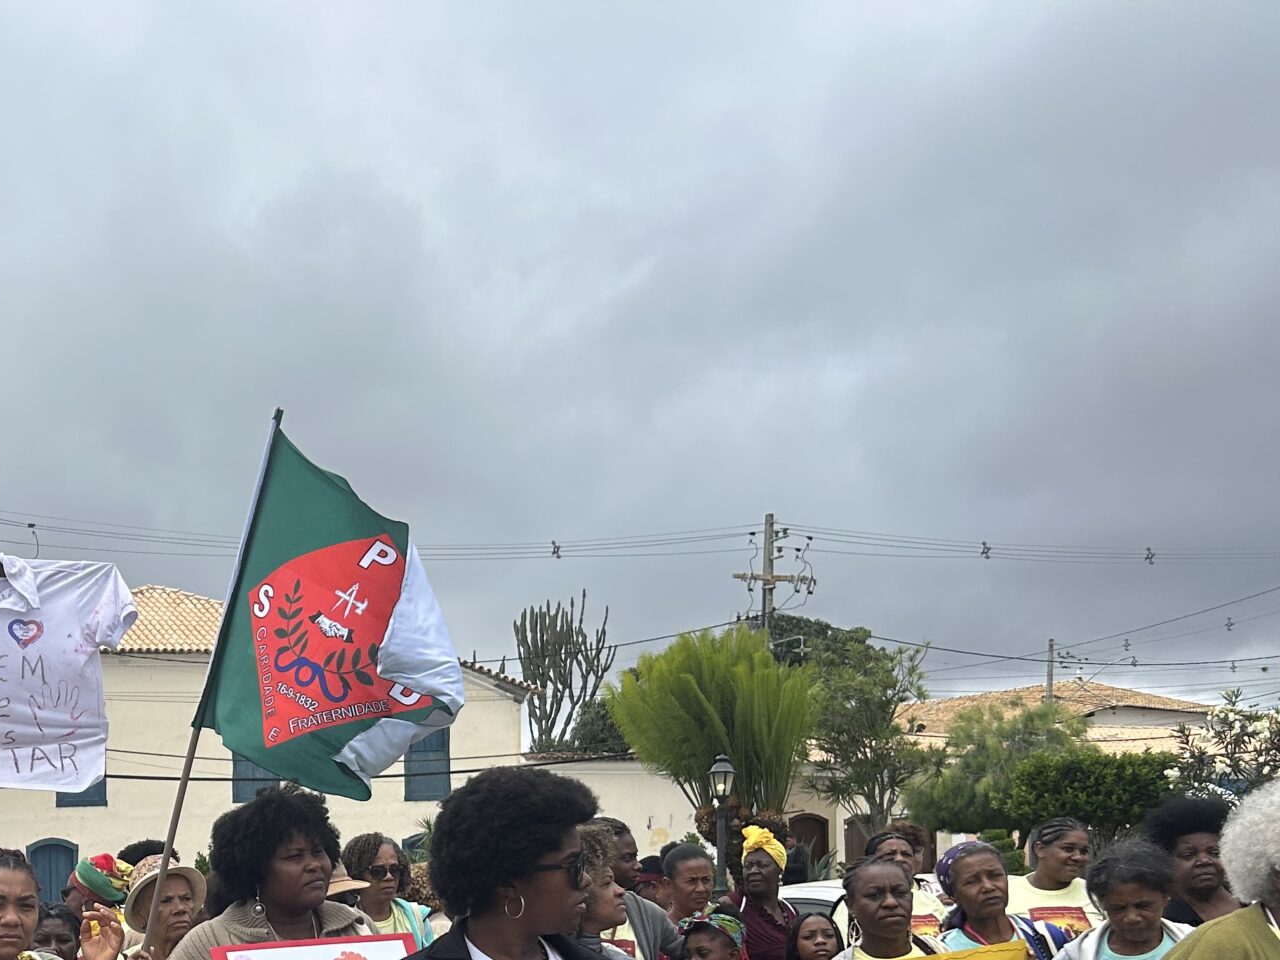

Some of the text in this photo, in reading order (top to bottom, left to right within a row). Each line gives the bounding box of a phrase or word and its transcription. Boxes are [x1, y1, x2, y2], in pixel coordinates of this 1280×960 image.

[255, 626, 277, 719] CARIDADE
[288, 699, 391, 735] FRATERNIDADE
[276, 682, 319, 712] 16-9-1832
